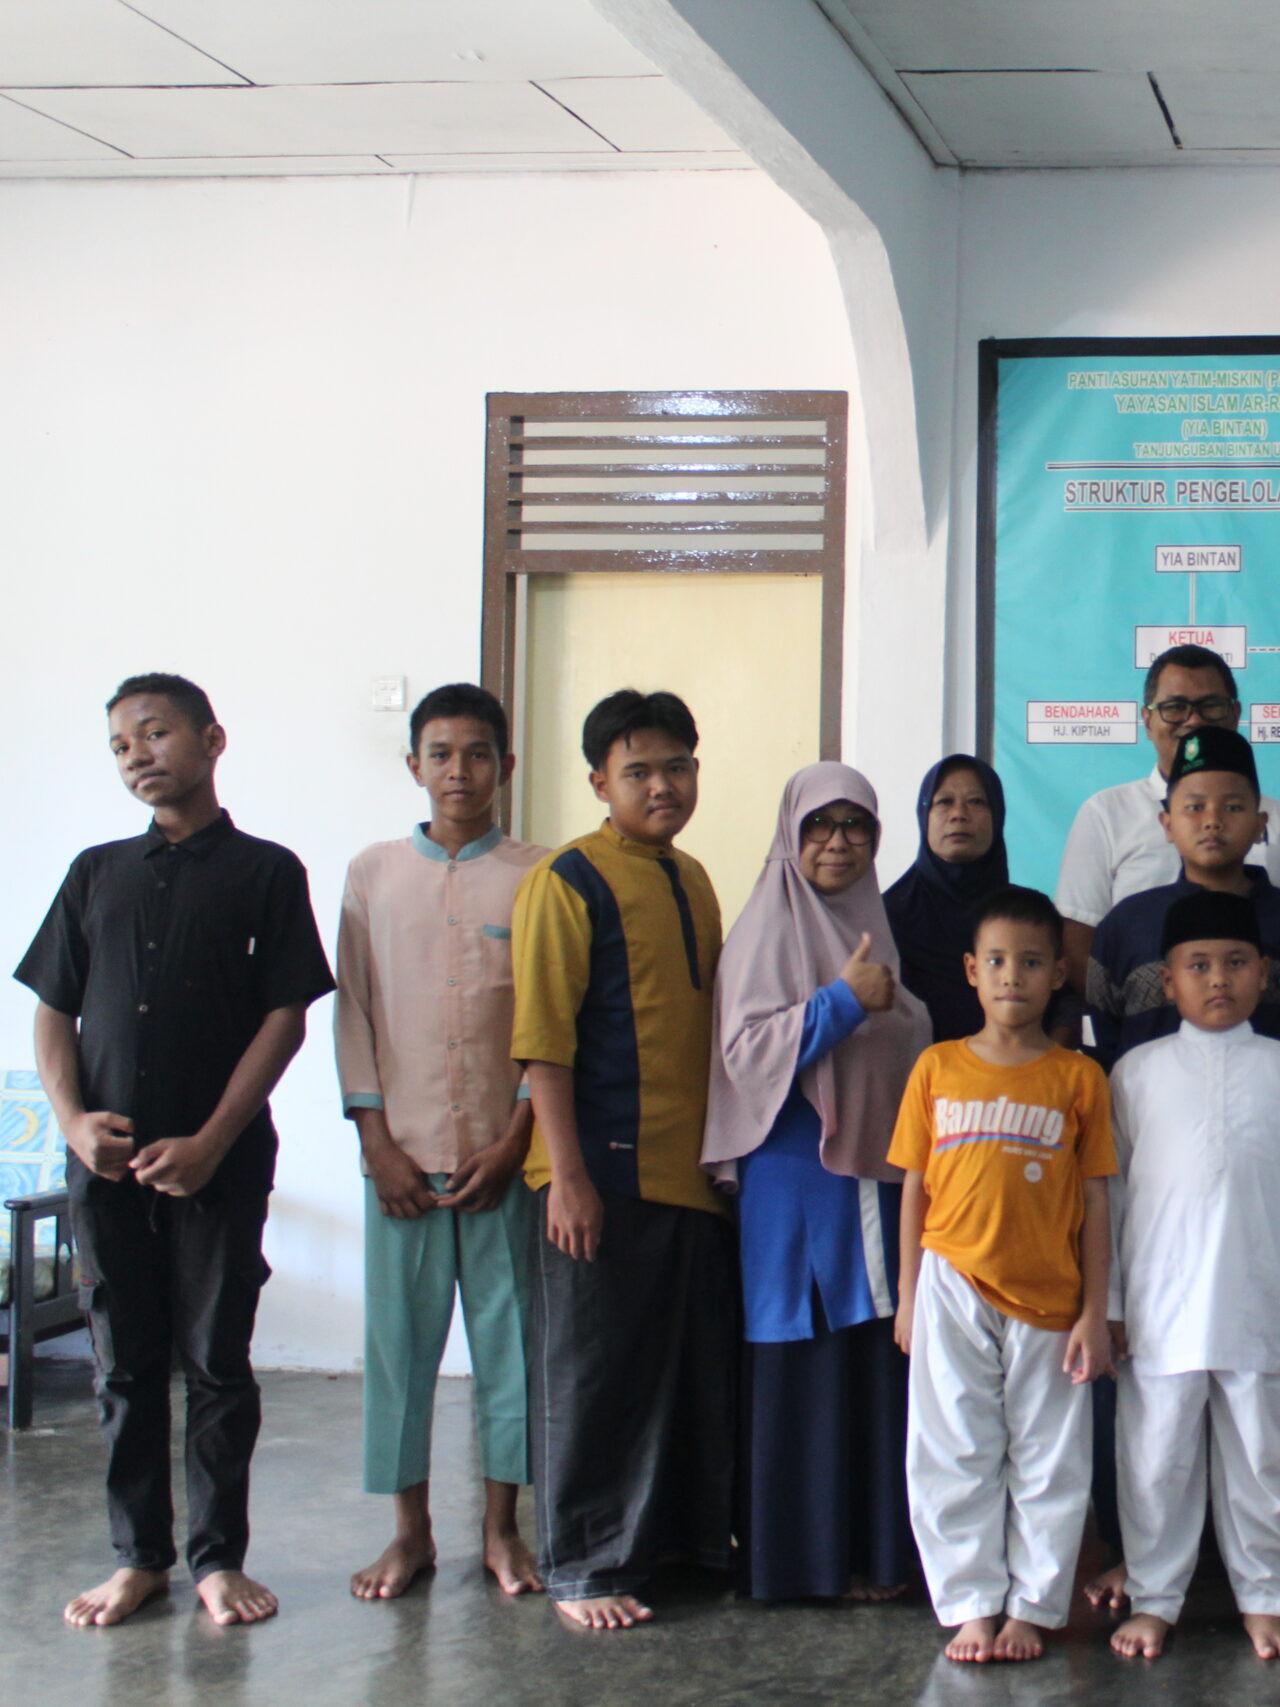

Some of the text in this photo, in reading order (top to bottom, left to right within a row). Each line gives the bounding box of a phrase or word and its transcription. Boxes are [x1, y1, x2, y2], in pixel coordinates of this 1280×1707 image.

[1069, 372, 1108, 388] PANTI
[1113, 372, 1168, 388] ASUHAN
[1170, 371, 1262, 387] YATIM-MISKIN
[1116, 395, 1189, 412] YAYASAN
[1192, 395, 1238, 411] ISLAM
[1212, 420, 1267, 439] BINTAN)
[1226, 443, 1269, 456] BINTAN
[1065, 481, 1166, 504] STRUKTUR
[1162, 552, 1237, 567] YIA BINTAN
[1169, 631, 1215, 645] KETUA
[1044, 705, 1120, 719] BENDAHARA
[1053, 724, 1111, 737] HJ. KIPTIAH
[934, 1095, 1064, 1146] Bandung
